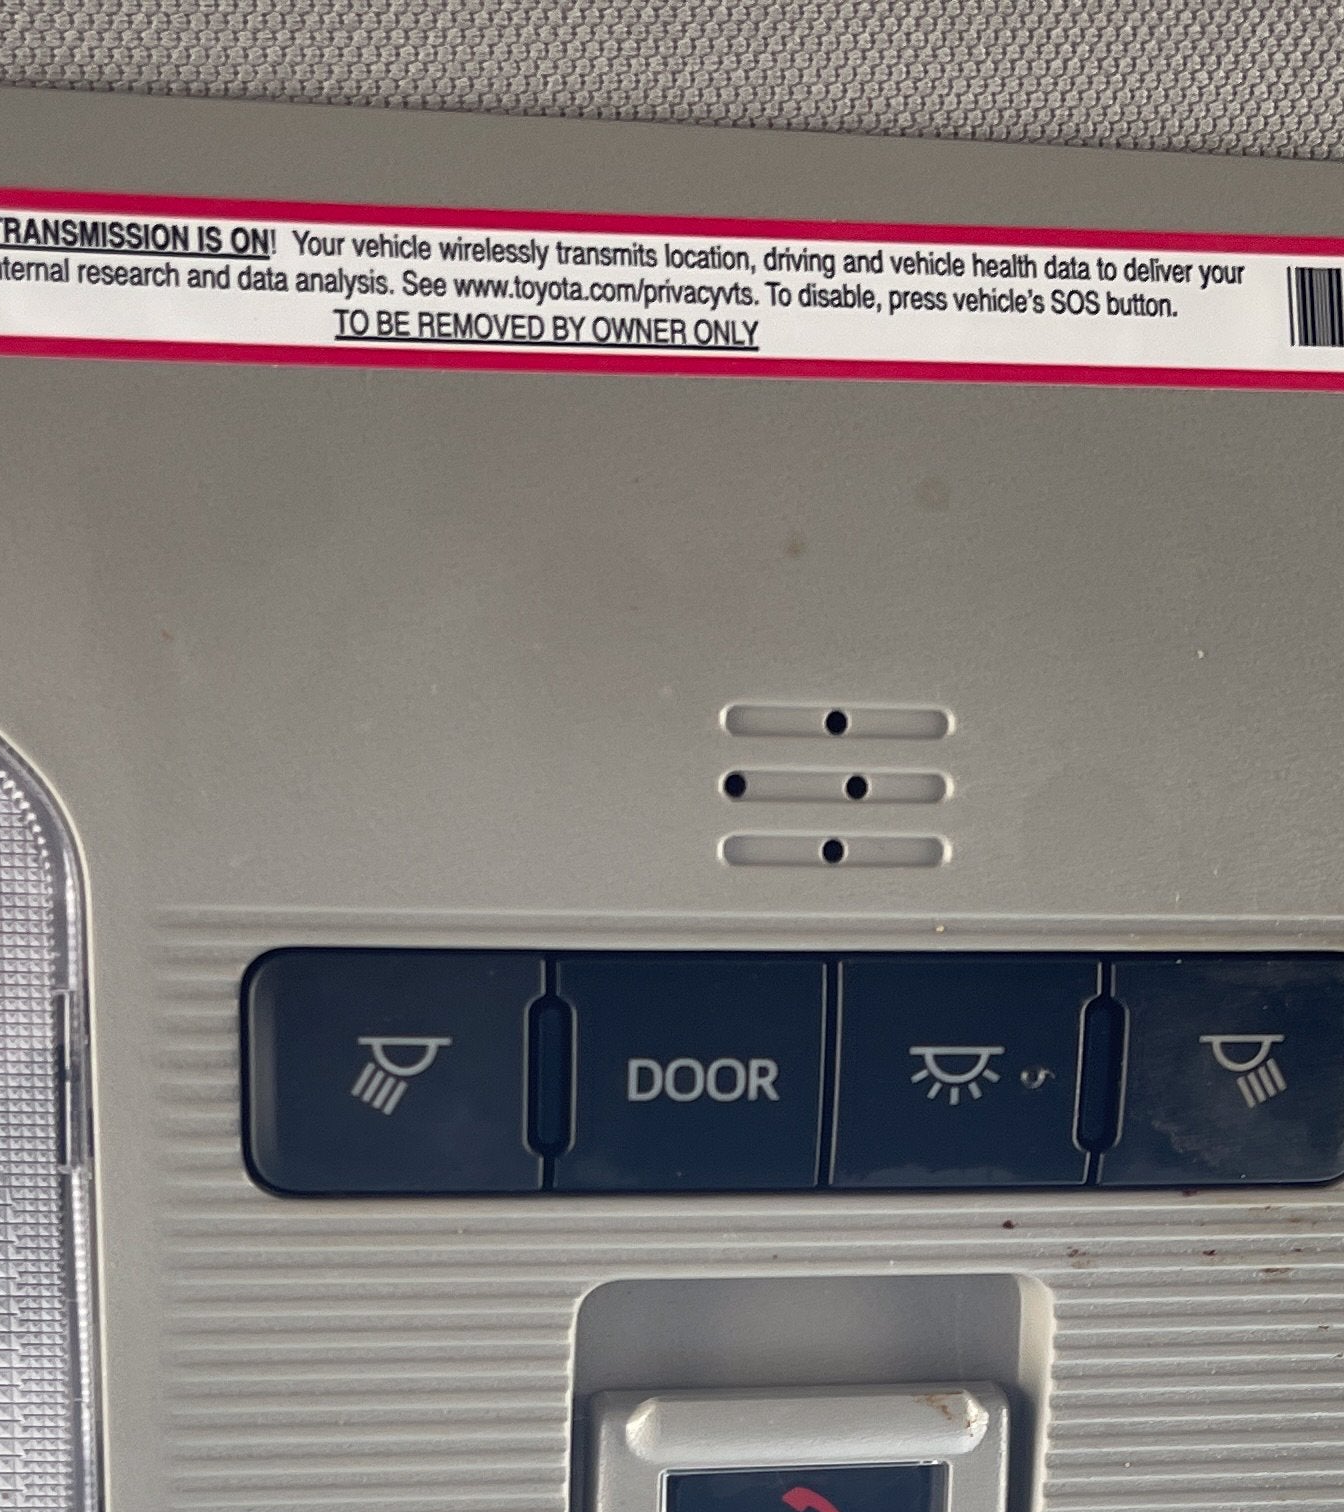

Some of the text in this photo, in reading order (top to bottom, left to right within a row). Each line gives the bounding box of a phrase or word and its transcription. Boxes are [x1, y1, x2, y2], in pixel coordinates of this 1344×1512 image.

[197, 226, 223, 253] IS
[230, 227, 276, 255] ON!
[293, 230, 345, 256] Your
[352, 232, 431, 260] vehicle
[438, 237, 549, 270] wirelessly
[556, 242, 657, 267] transmits
[665, 243, 755, 275] location,
[764, 246, 835, 278] driving
[843, 250, 883, 275] and
[890, 252, 964, 278] vehicle
[972, 252, 1037, 279] health
[1044, 255, 1090, 280] data
[1096, 257, 1117, 282] to
[1124, 258, 1192, 284] deliver
[1199, 262, 1244, 289] your
[77, 263, 180, 288] research
[187, 264, 230, 290] and
[237, 266, 288, 292] data
[295, 267, 394, 299] analysis.
[401, 270, 446, 297] See
[454, 276, 759, 310] www.toyota.com/privacyvts.
[765, 282, 791, 308] To
[798, 282, 882, 314] disable,
[889, 290, 948, 315] press
[953, 287, 1045, 314] vehicle's
[1051, 289, 1100, 316] SOS
[1106, 292, 1178, 318] button.
[333, 308, 759, 346] TO BE REMOVED BY OWNER ONLY
[627, 1057, 781, 1102] DOOR
